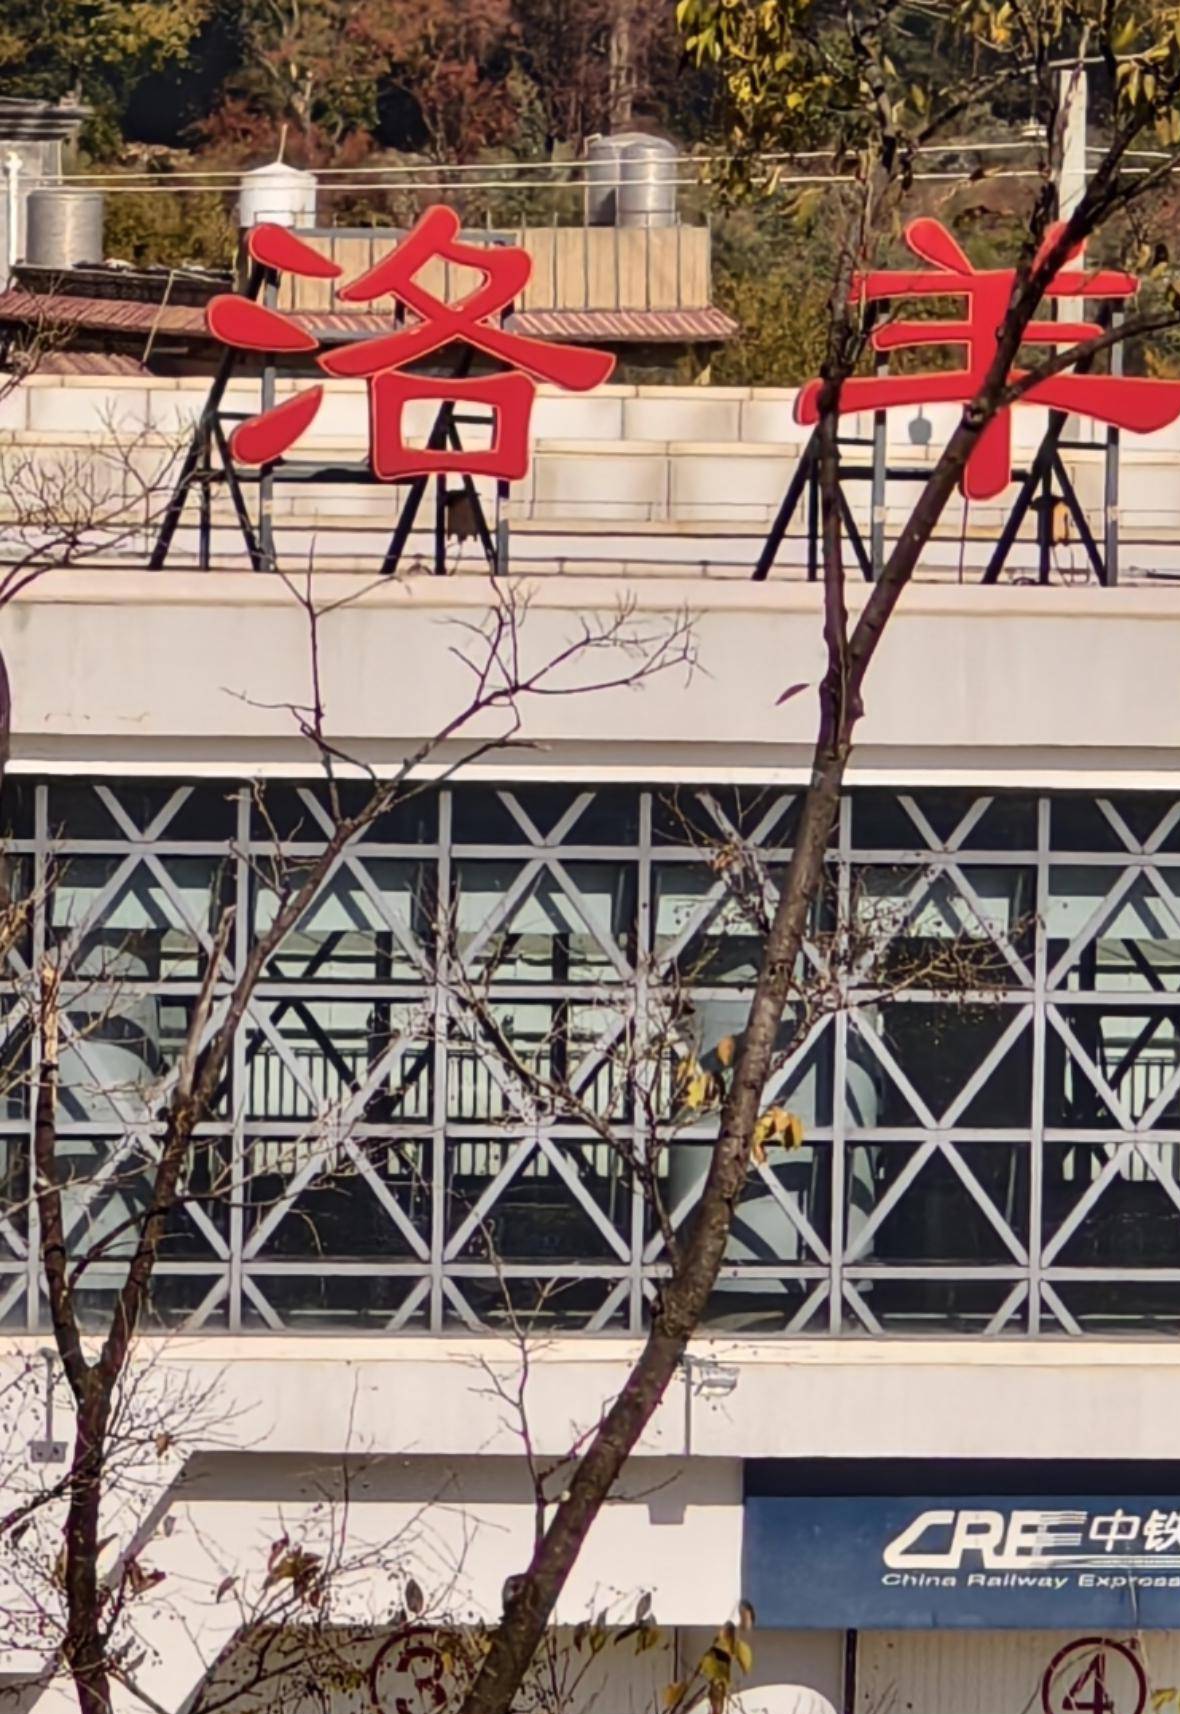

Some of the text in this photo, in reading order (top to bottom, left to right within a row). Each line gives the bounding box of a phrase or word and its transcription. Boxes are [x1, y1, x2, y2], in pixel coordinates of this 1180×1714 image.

[883, 1510, 1088, 1569] CRE
[881, 1573, 957, 1588] China
[967, 1573, 1069, 1590] Railway
